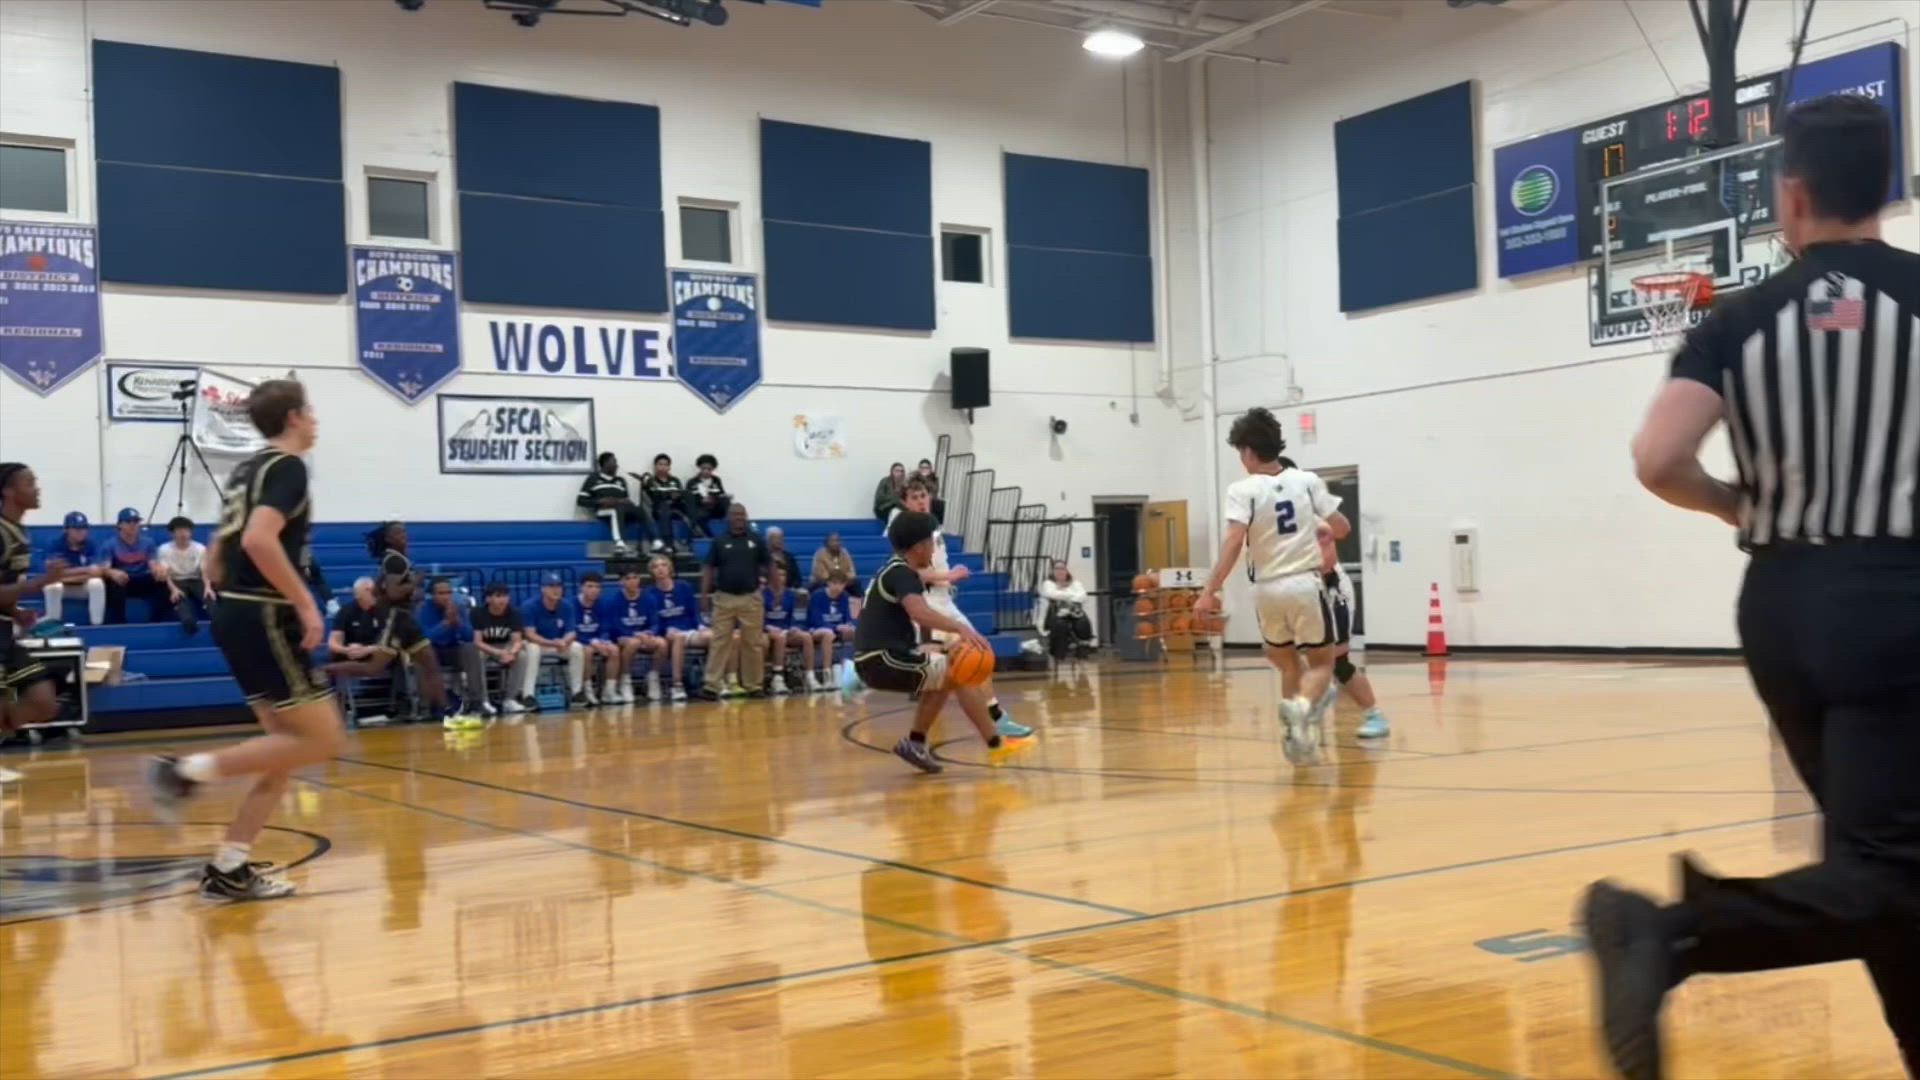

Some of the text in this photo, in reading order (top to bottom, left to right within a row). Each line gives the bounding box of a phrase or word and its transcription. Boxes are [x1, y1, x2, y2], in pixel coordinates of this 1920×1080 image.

[1582, 120, 1628, 144] GUEST
[356, 258, 453, 291] CHAMPIONS
[674, 280, 755, 311] CHAMPIONS
[494, 407, 541, 435] SFCA
[447, 439, 588, 462] STUDENT SECTION
[1275, 500, 1297, 535] 2
